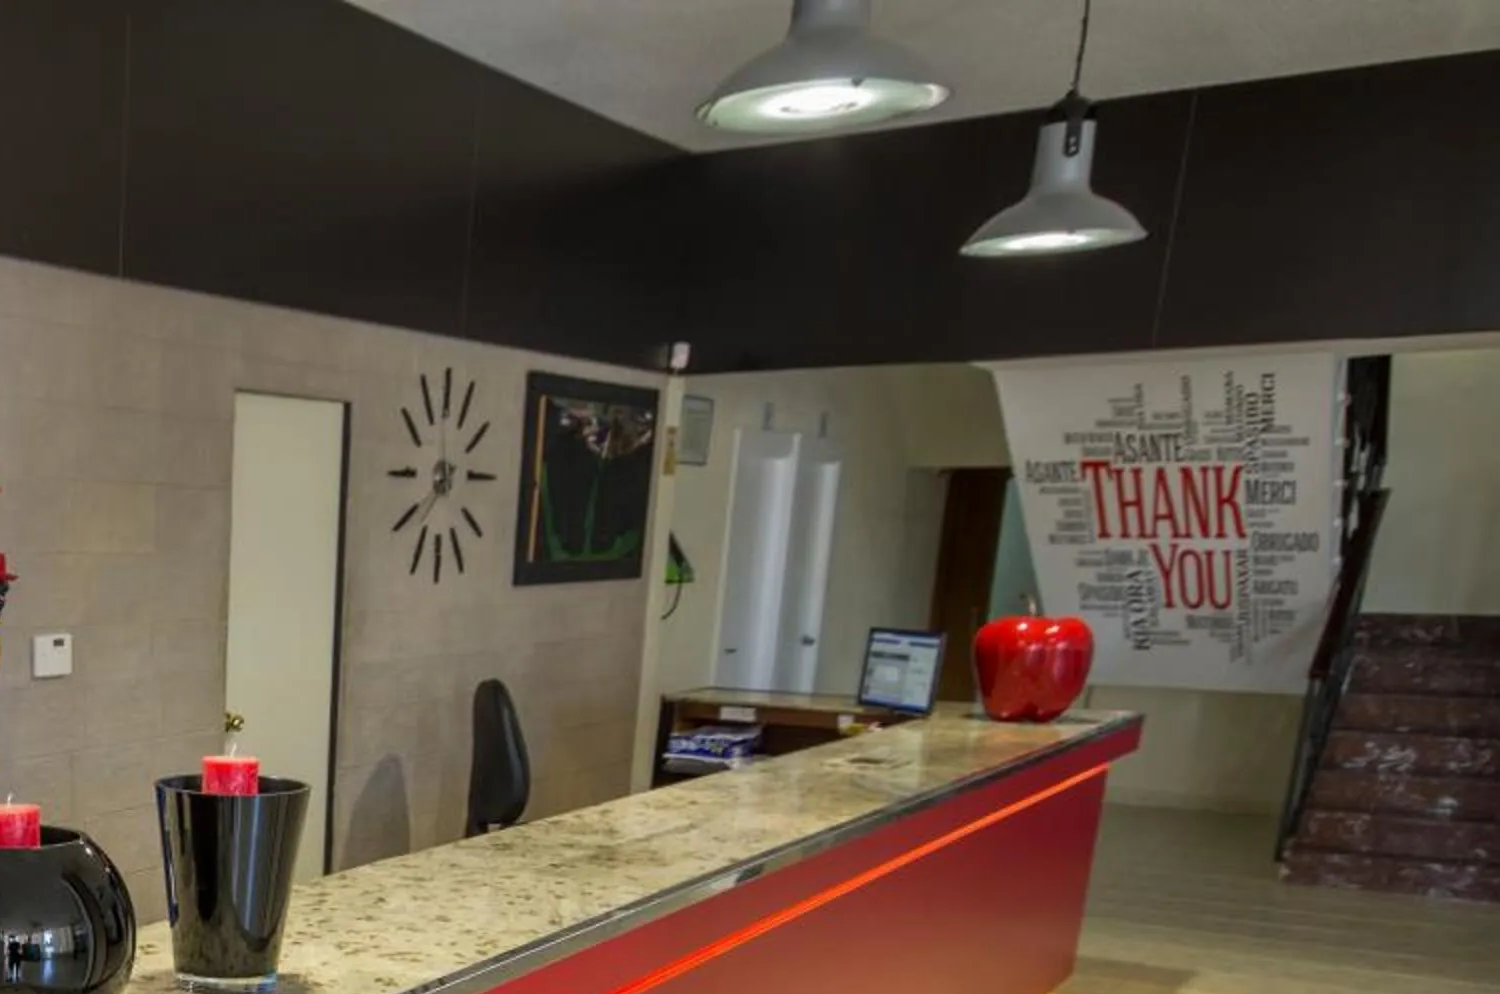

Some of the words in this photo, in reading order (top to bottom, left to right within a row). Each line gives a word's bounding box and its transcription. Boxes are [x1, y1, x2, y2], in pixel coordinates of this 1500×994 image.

[1261, 373, 1275, 433] MERCI
[1114, 431, 1182, 461] ASANTE
[1081, 461, 1247, 540] THANK
[1245, 479, 1296, 504] MERCI
[1149, 543, 1233, 611] YOU
